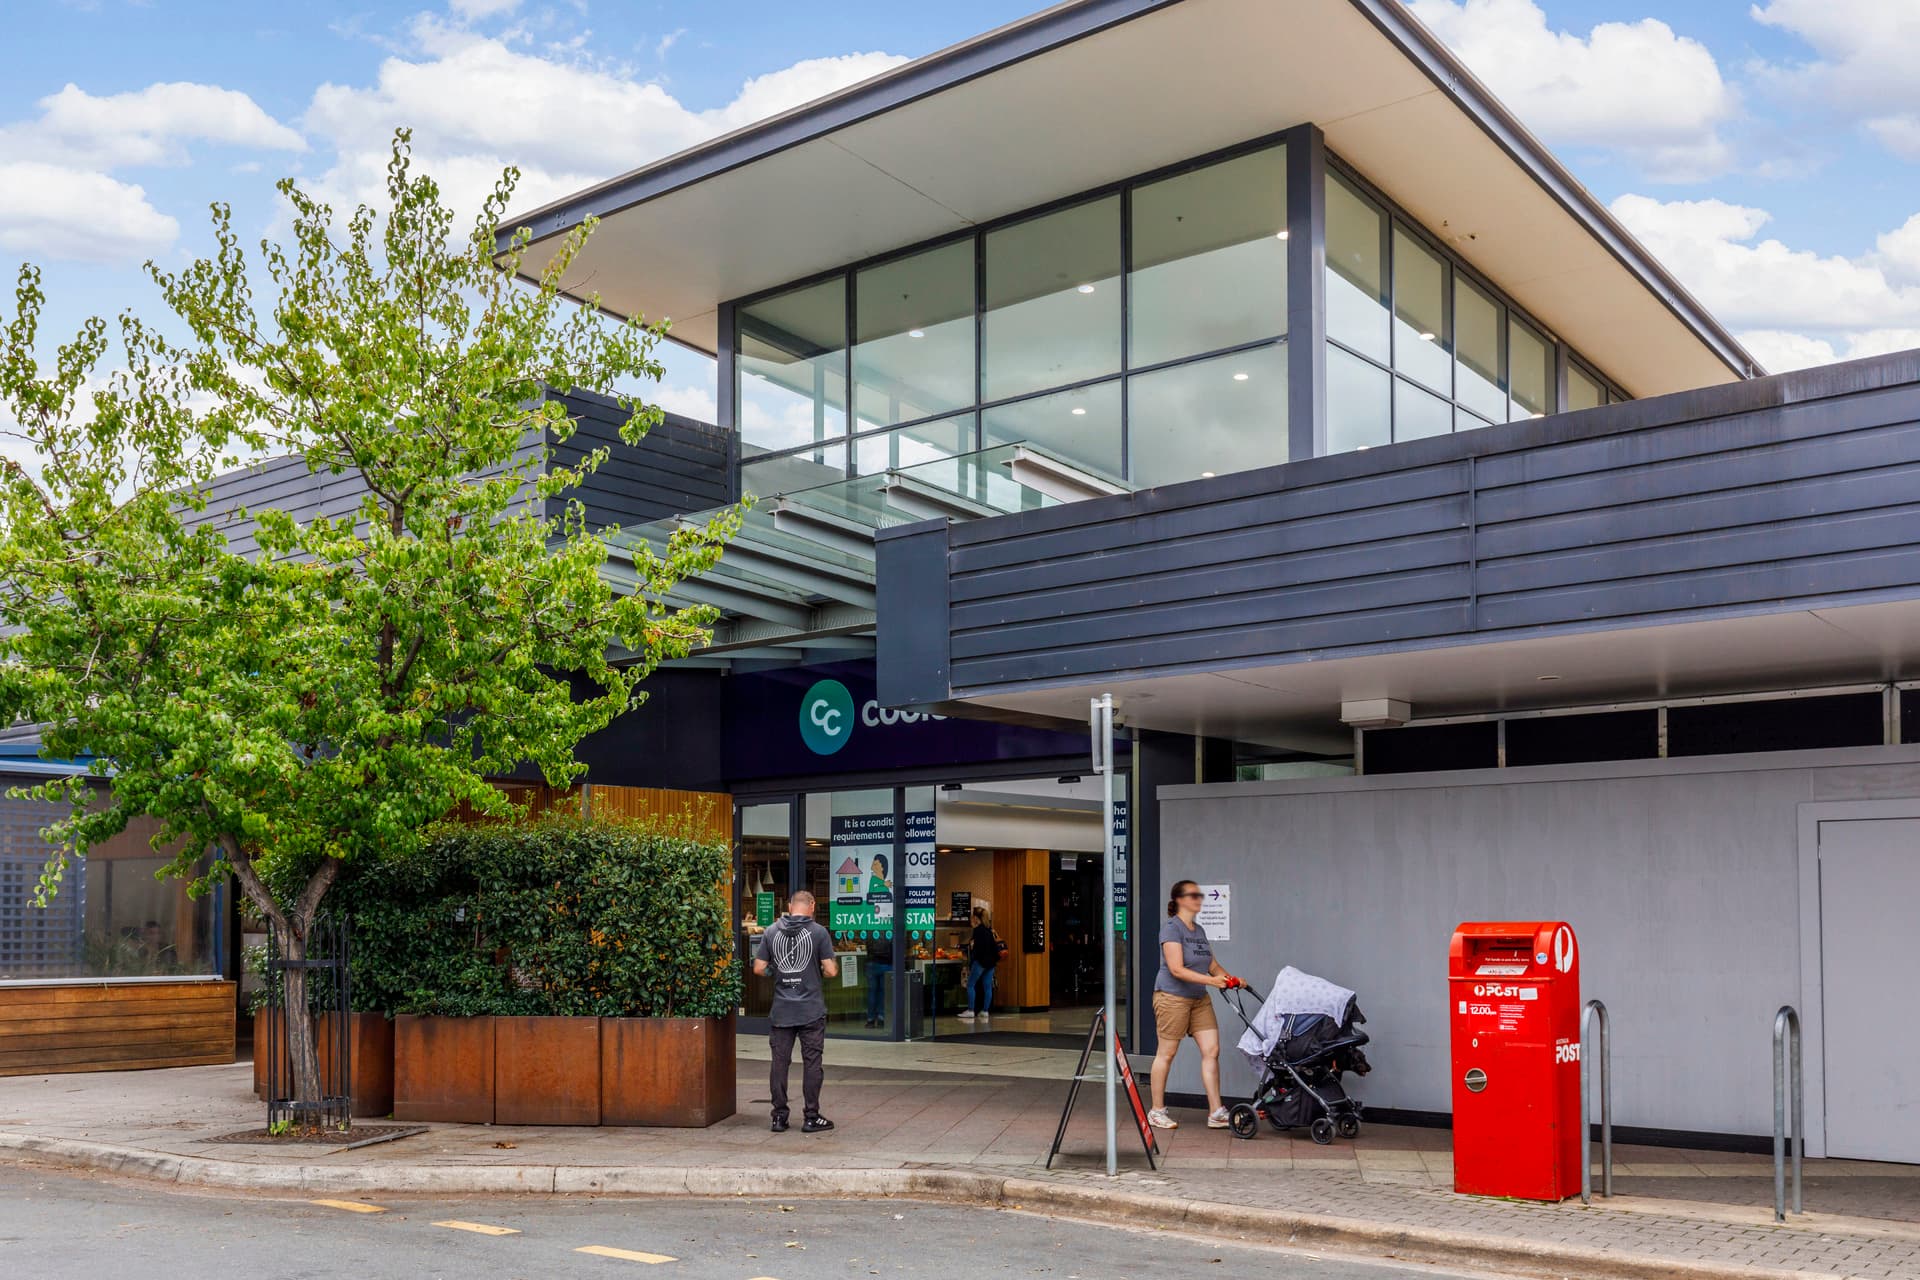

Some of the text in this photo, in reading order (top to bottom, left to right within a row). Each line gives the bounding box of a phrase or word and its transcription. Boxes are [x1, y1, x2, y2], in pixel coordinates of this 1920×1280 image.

[845, 819, 851, 828] It
[852, 818, 859, 828] is
[906, 815, 914, 825] of
[833, 831, 885, 843] requirements
[904, 852, 936, 866] OGE
[835, 913, 864, 925] STAY
[1486, 986, 1519, 997] POST
